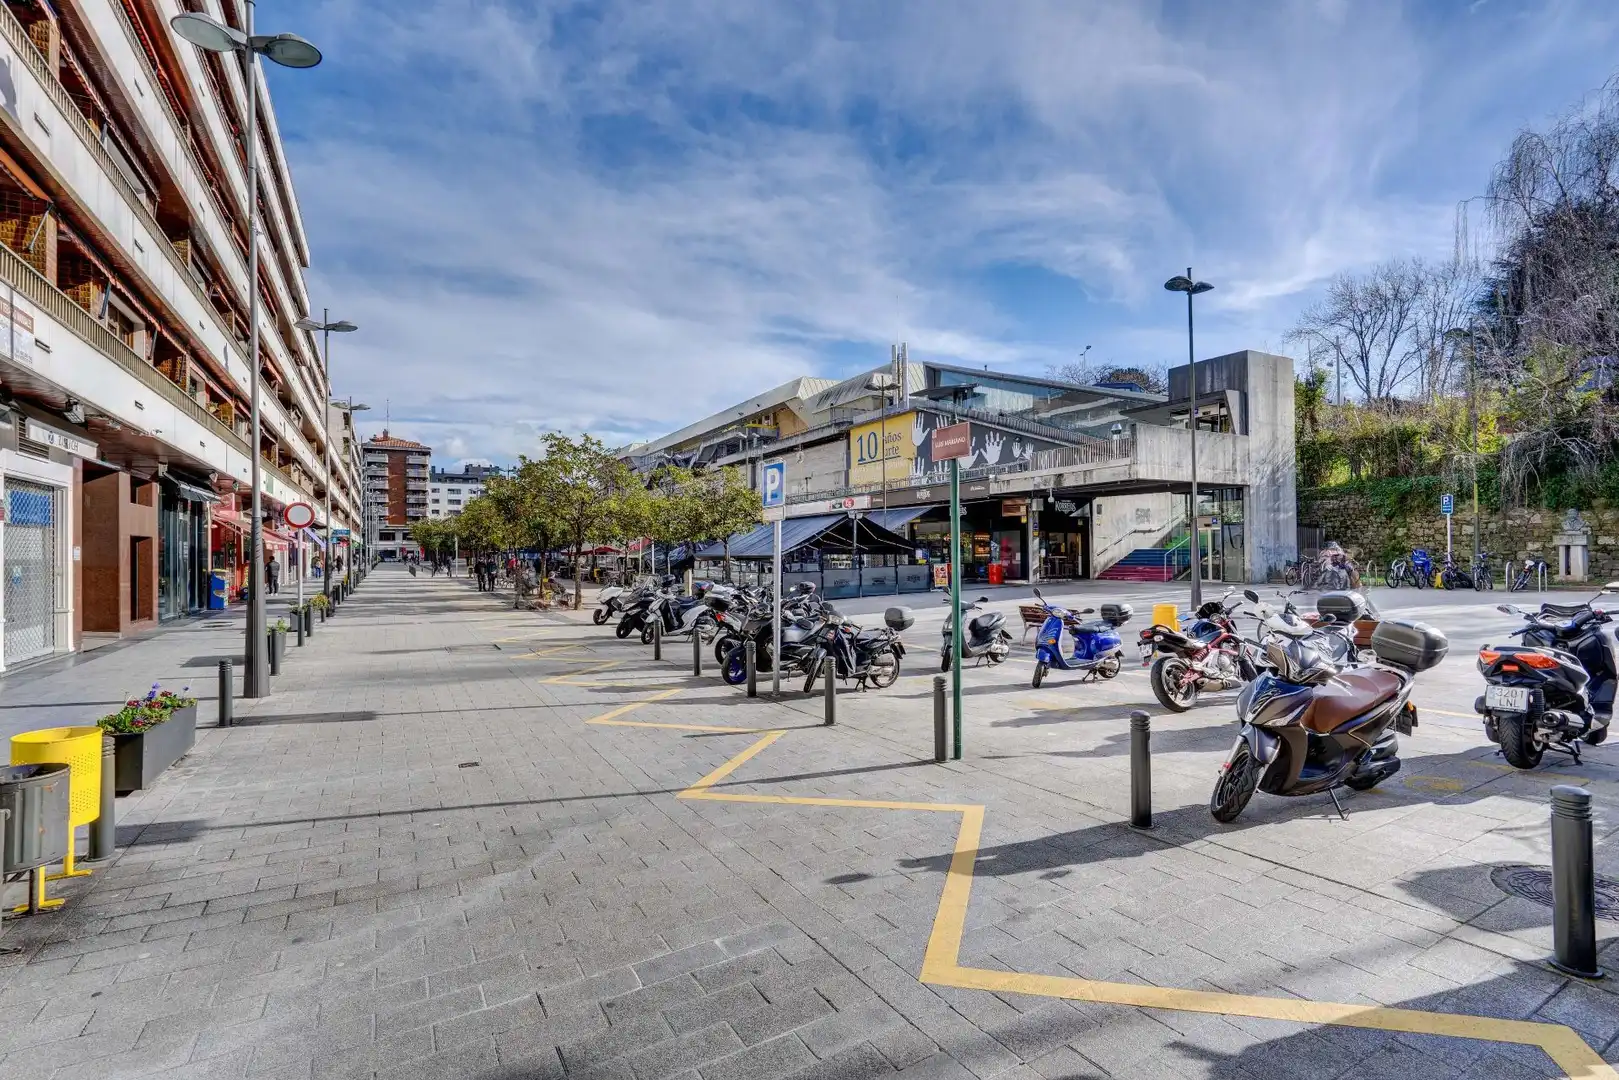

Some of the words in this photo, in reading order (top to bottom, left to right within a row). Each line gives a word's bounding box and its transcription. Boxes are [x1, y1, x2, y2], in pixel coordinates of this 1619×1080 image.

[857, 431, 878, 462] 10
[766, 467, 780, 503] P
[1443, 496, 1450, 505] P
[1496, 687, 1524, 699] 3201
[1499, 698, 1520, 708] LNL
